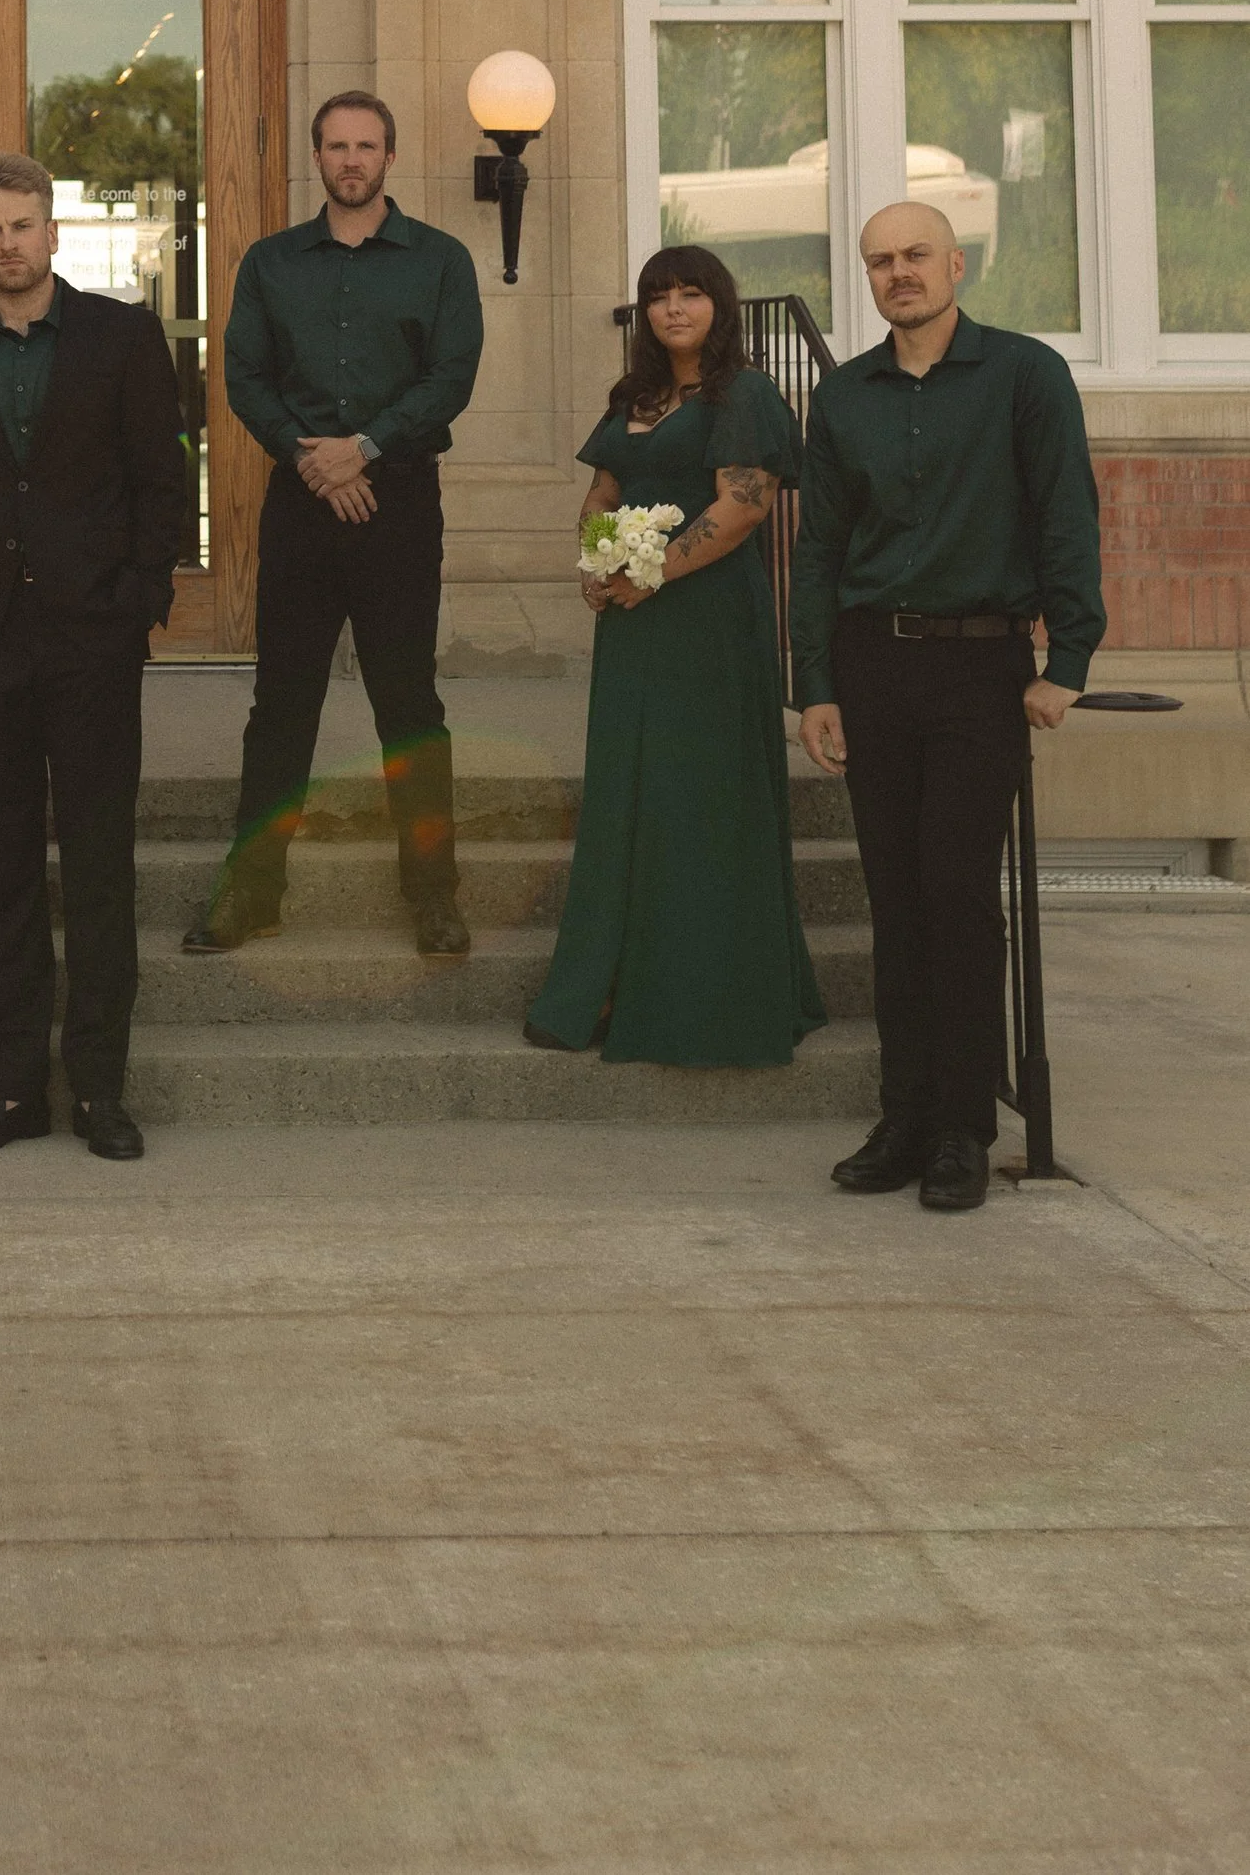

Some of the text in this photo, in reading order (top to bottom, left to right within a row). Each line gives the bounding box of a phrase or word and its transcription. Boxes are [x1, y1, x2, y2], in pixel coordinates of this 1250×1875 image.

[100, 189, 140, 202] come
[145, 187, 159, 202] to
[164, 187, 187, 202] the
[96, 236, 132, 250] north
[138, 236, 167, 250] side
[173, 235, 188, 251] of
[71, 261, 94, 274] the
